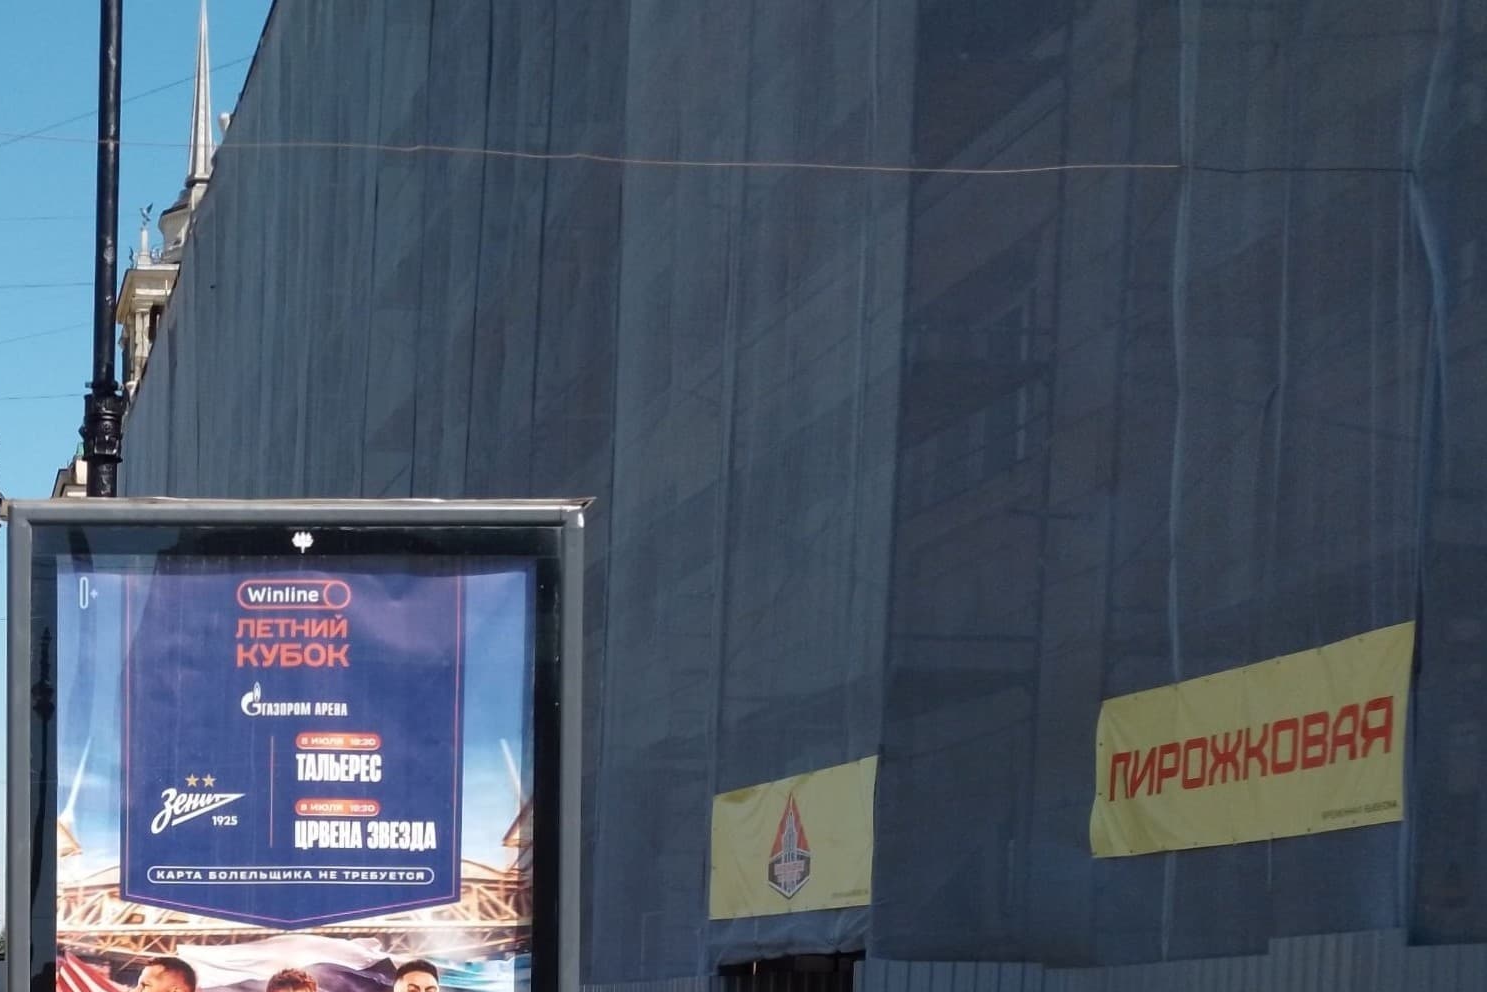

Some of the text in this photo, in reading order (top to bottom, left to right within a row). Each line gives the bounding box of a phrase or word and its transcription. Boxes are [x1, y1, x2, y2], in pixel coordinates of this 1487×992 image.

[248, 586, 319, 603] Winline
[235, 614, 348, 638] ЛЕТНИЙ
[236, 642, 350, 667] КУБОК
[262, 702, 348, 716] ГАЗПРОМ АРЕНА
[1109, 695, 1395, 802] ПИРОЖКОВАЯ
[295, 753, 382, 782] ТАЛЬЕРЕС
[151, 787, 246, 834] Зенит
[212, 815, 238, 826] 1925
[294, 820, 437, 851] ЦРВЕНА ЗВЕЗДА
[156, 870, 425, 881] КАРТА БОЛЕЛЬЩИКА НЕ ТРЕБУЕТСЯ
